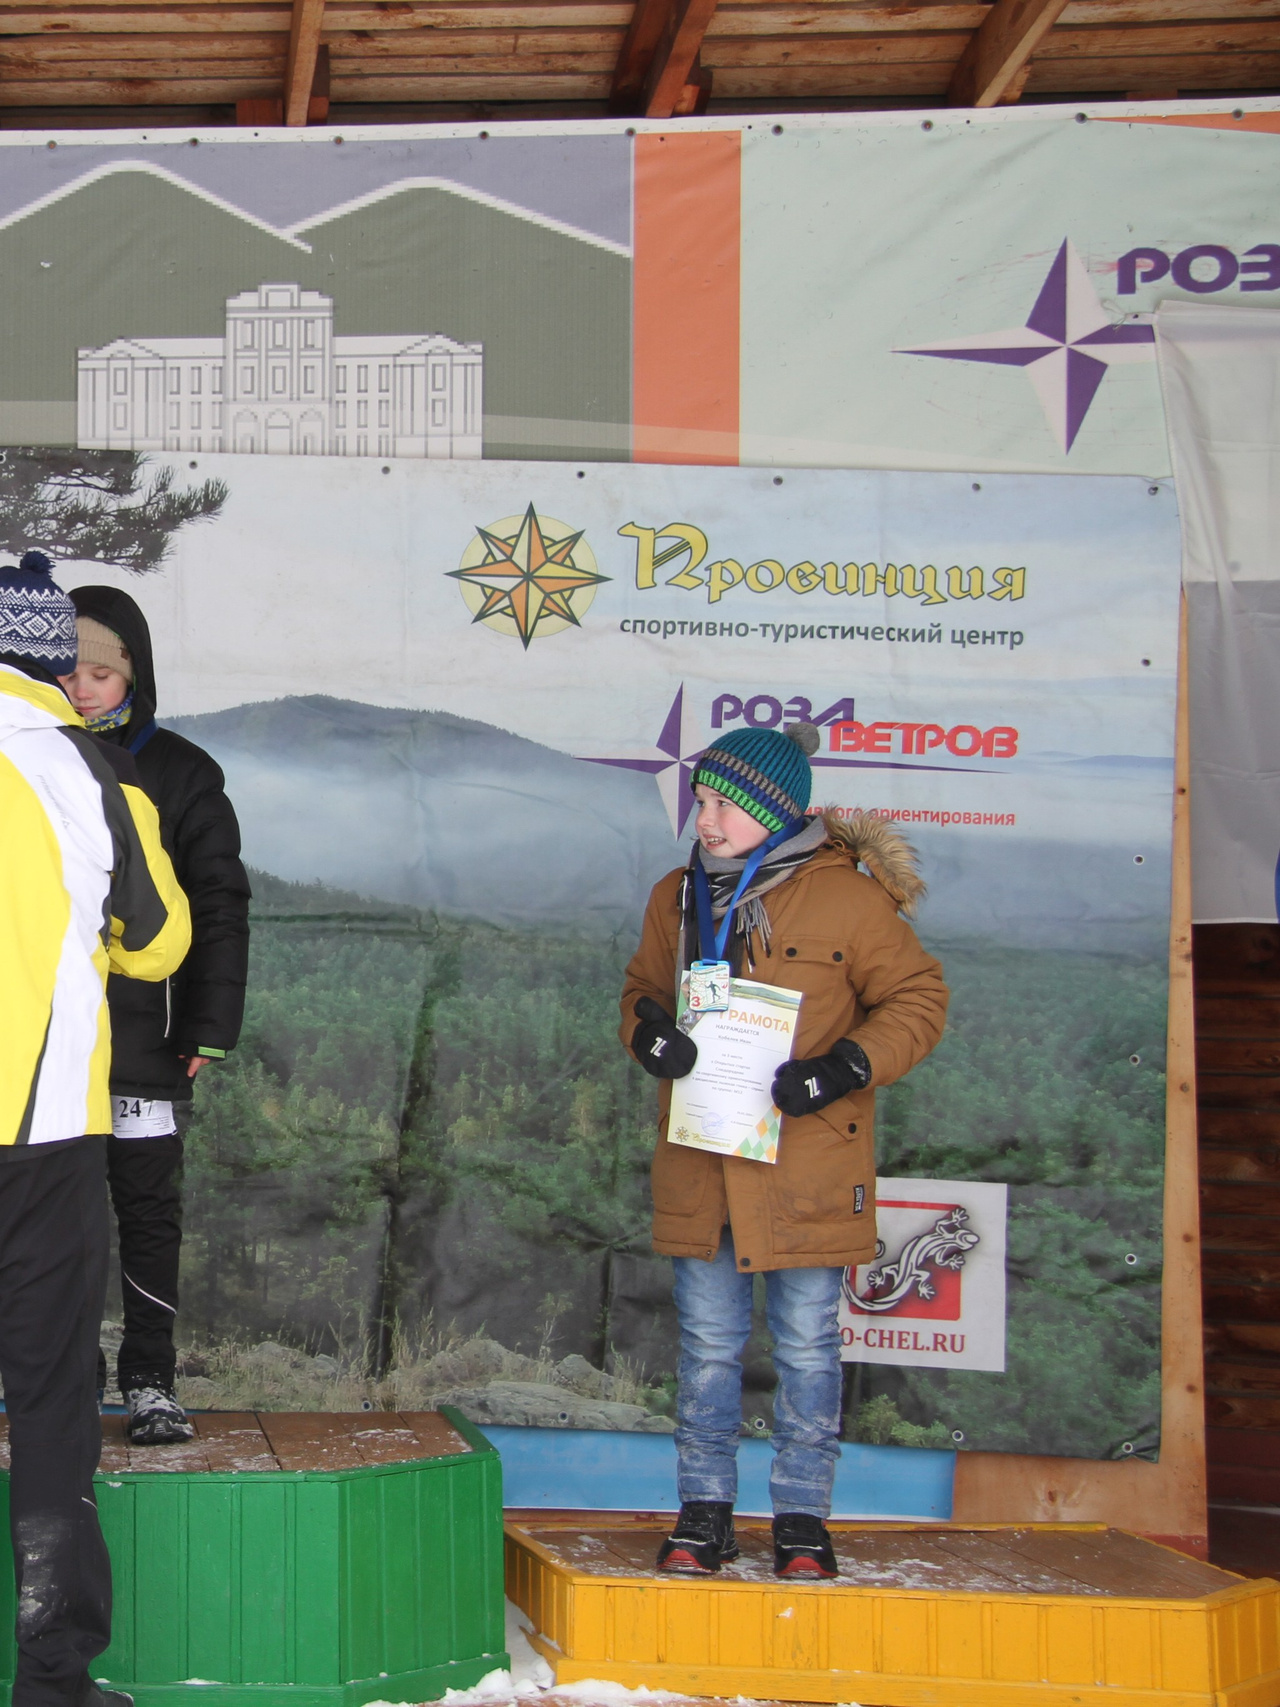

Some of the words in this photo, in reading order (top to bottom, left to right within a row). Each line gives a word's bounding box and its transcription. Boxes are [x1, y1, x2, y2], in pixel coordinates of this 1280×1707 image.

[617, 521, 1026, 606] Провинция
[620, 616, 943, 645] спортивно-туристический
[950, 625, 1025, 650] центр
[829, 720, 1018, 758] ВЕТРОВ
[691, 996, 701, 1007] 3
[716, 1024, 760, 1036] НАГРАЖДАЕТСЯ
